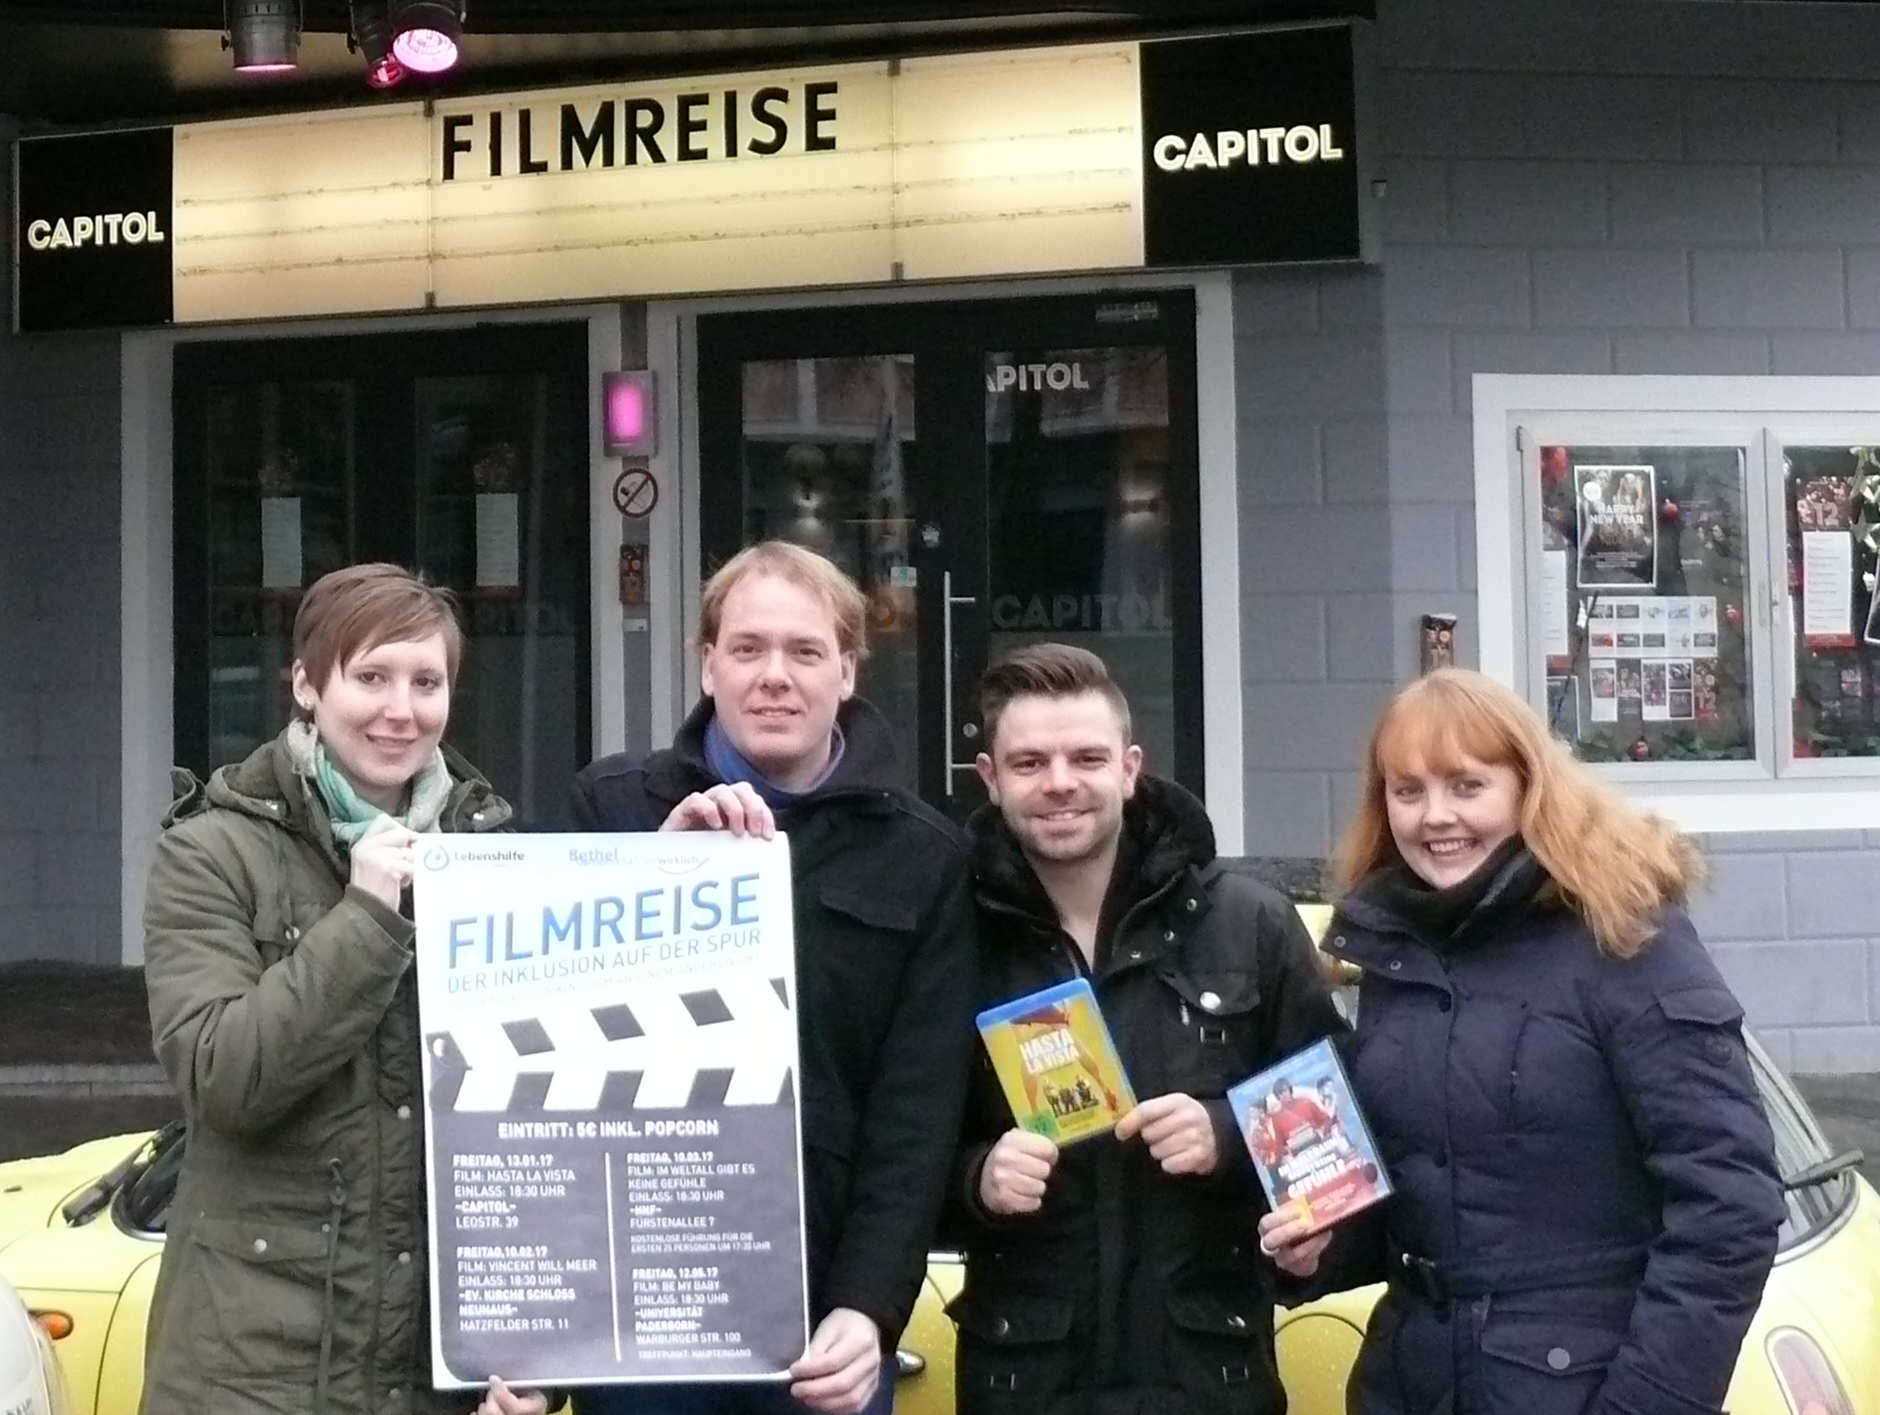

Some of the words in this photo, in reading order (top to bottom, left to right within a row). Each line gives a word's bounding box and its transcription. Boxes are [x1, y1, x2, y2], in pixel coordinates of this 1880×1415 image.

[442, 81, 838, 180] FILMREISE
[1153, 124, 1343, 171] CAPITOL
[27, 211, 164, 251] CAPITOL
[454, 849, 525, 862] Lebenshilfe
[569, 847, 618, 862] Bethel
[448, 872, 760, 969] FILMREISE
[448, 972, 487, 994] DER
[494, 954, 605, 988] INKLUSION
[612, 946, 652, 968] AUF
[660, 937, 699, 961] DER
[706, 928, 761, 953] SPUR
[1019, 1028, 1075, 1061] HASTA
[1025, 1056, 1044, 1075] LA
[498, 1122, 574, 1139] EINTRITT:
[600, 1121, 642, 1137] INKL.
[645, 1120, 719, 1136] POPCORN
[507, 1153, 553, 1167] 13.01.17
[673, 1151, 714, 1163] 10.03.17
[454, 1170, 485, 1182] FILM:
[487, 1170, 524, 1182] HASTA
[526, 1170, 542, 1182] LA
[543, 1169, 576, 1181] VISTA
[628, 1165, 655, 1176] FILM:
[656, 1165, 669, 1176] IM
[670, 1164, 714, 1175] WELTALL
[717, 1164, 739, 1174] GIBT
[742, 1163, 755, 1174] ES
[628, 1179, 658, 1189] KEINE
[660, 1177, 707, 1189] GEFÜHLE
[455, 1185, 506, 1197] EINLASS:
[510, 1185, 538, 1197] 18:30
[540, 1185, 566, 1196] UHR
[629, 1191, 674, 1203] EINLASS:
[702, 1190, 725, 1201] UHR
[456, 1216, 502, 1229] LEOSTR.
[506, 1216, 519, 1228] 39
[630, 1216, 707, 1229] FÜRSTENALLEE
[709, 1216, 715, 1227] 7
[458, 1261, 486, 1272] FILM:
[488, 1260, 535, 1272] VINCENT
[537, 1260, 564, 1271] WILL
[566, 1259, 597, 1270] MEER
[458, 1275, 506, 1287] EINLASS:
[510, 1275, 536, 1286] 18:30
[538, 1275, 562, 1286] UHR
[662, 1281, 675, 1291] BE
[678, 1280, 691, 1291] MY
[694, 1280, 720, 1290] BABY
[484, 1289, 525, 1300] KIRCHE
[526, 1288, 576, 1300] SCHLOSS
[634, 1294, 678, 1305] EINLASS:
[707, 1293, 729, 1303] UHR
[460, 1319, 529, 1331] HATZFELDER
[531, 1319, 555, 1330] STR.
[558, 1318, 569, 1329] 11
[636, 1333, 698, 1345] WARBURGER
[700, 1332, 722, 1343] STR.
[725, 1331, 741, 1343] 100
